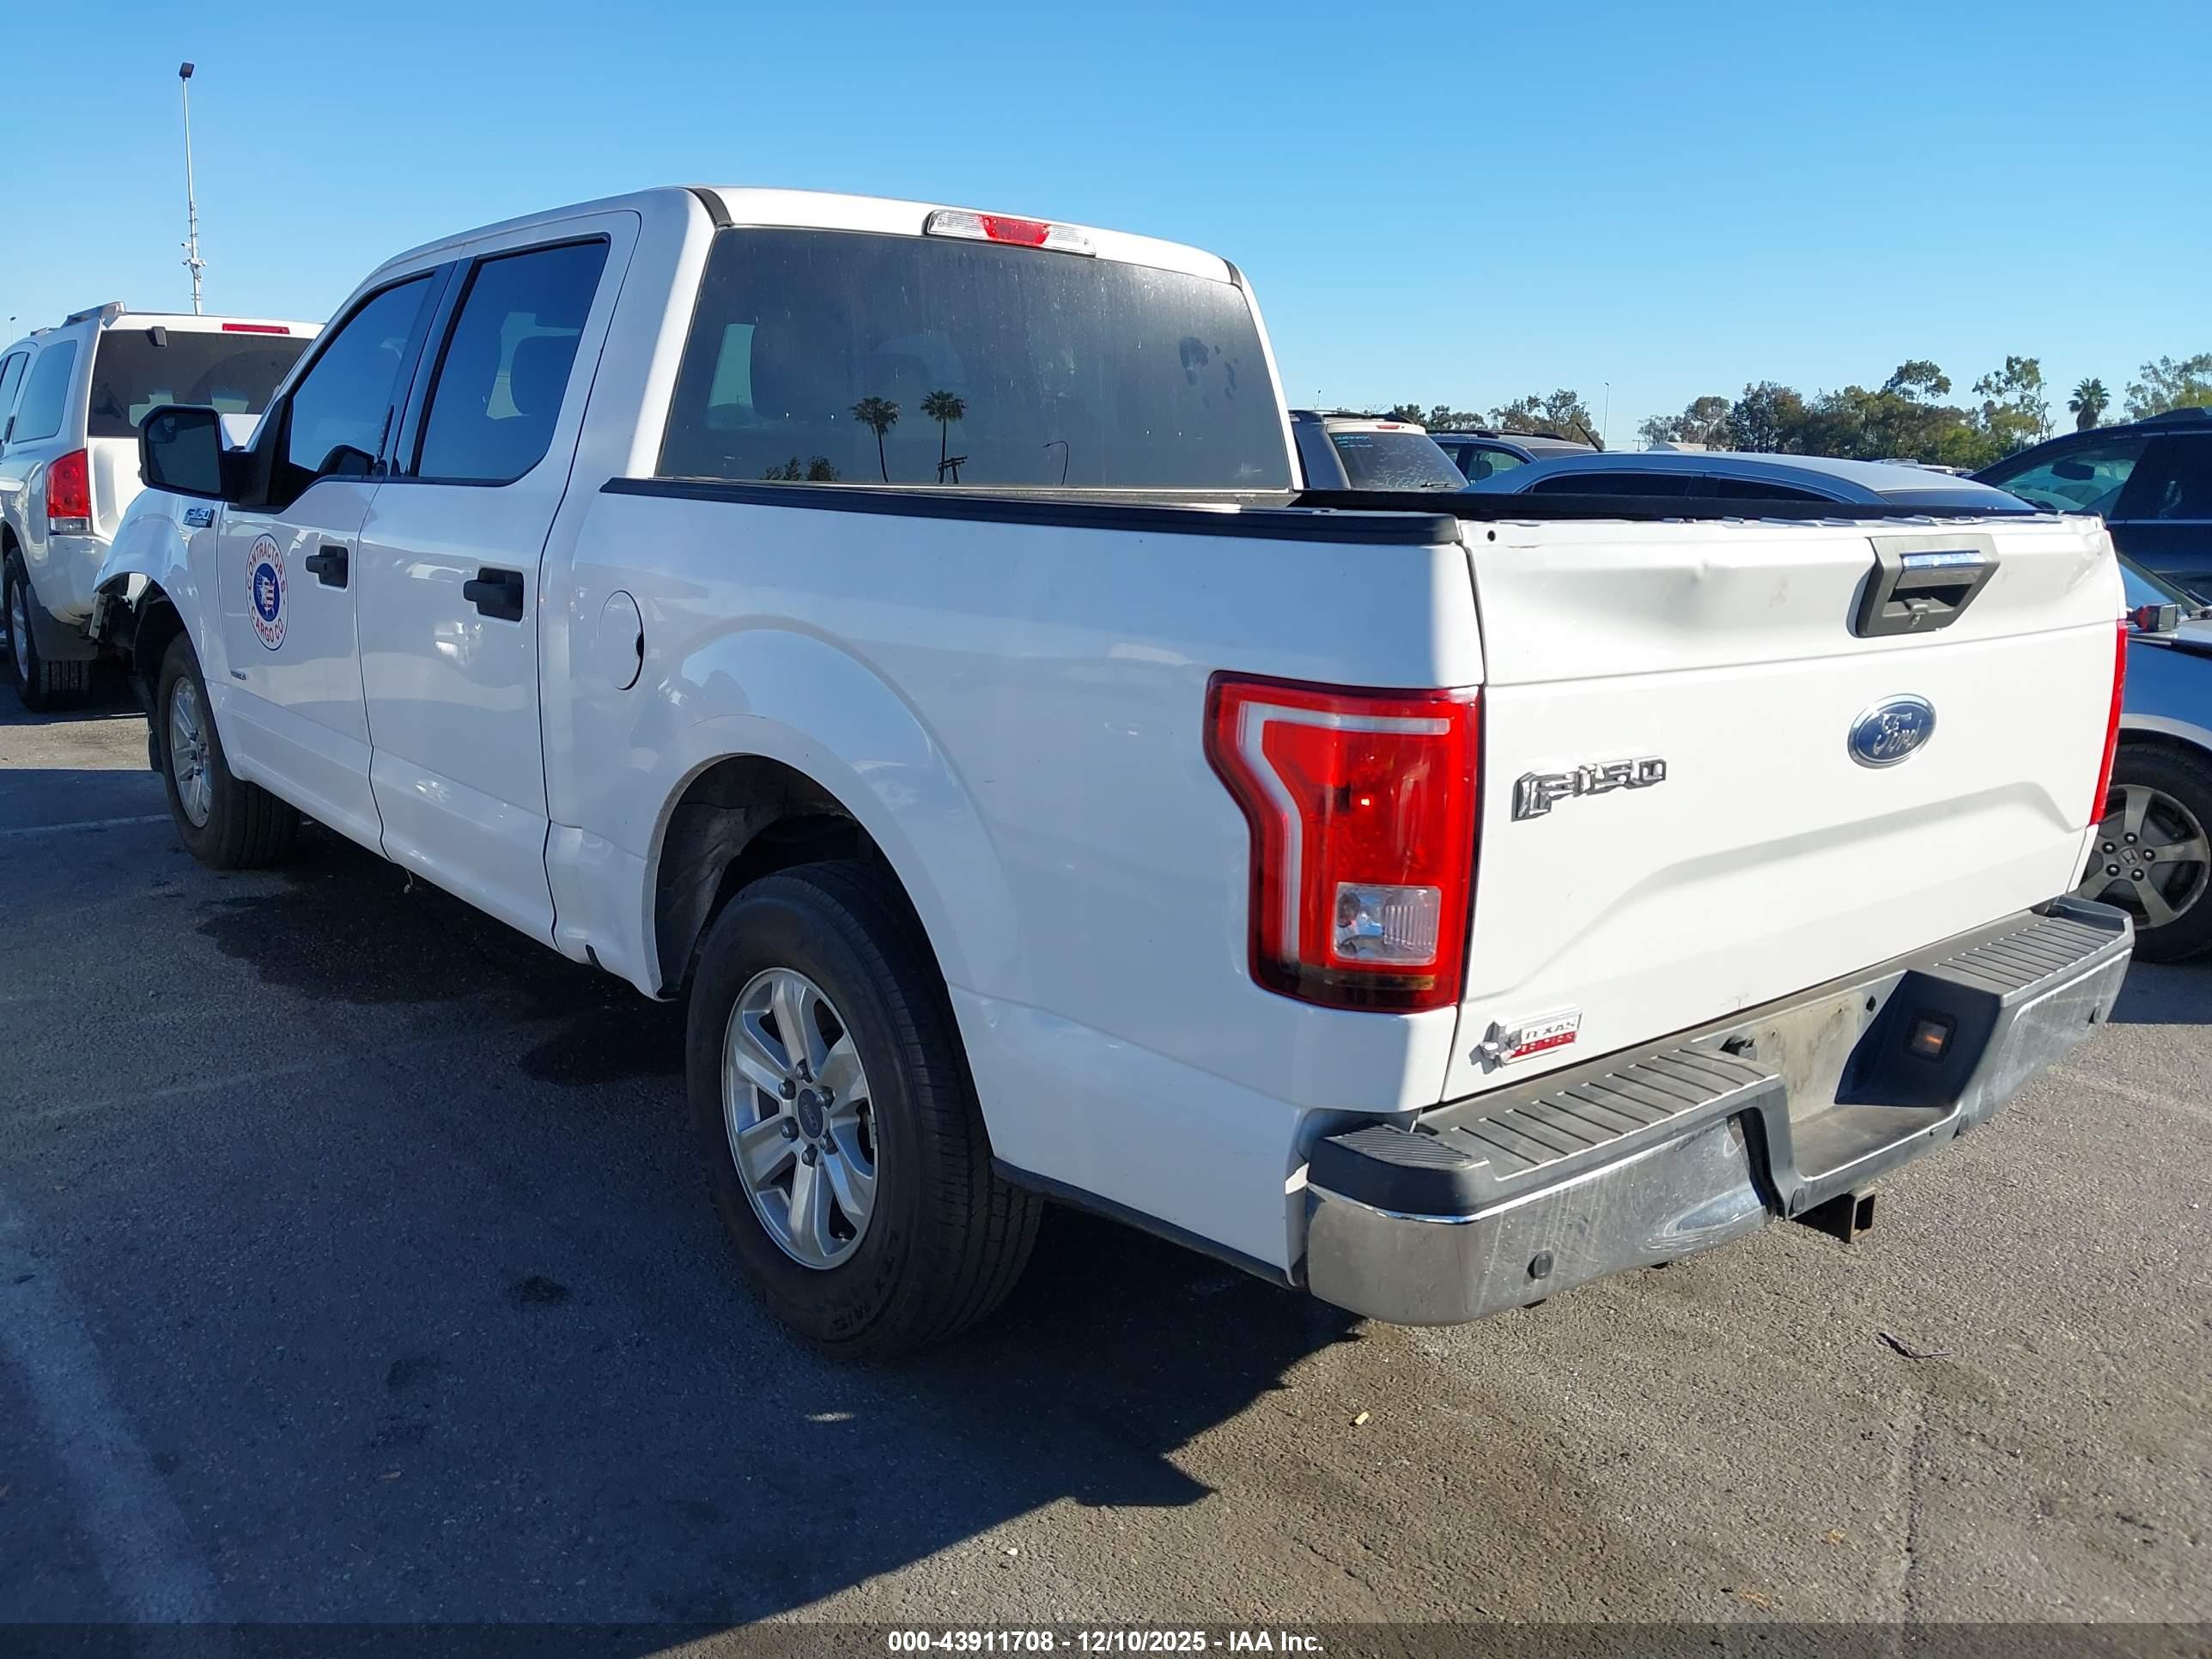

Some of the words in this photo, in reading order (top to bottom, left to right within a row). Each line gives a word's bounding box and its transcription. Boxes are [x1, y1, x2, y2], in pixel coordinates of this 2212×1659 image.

[247, 541, 287, 593] CONTRACTORS
[252, 606, 275, 644] CARGO
[1873, 712, 1923, 756] Ford
